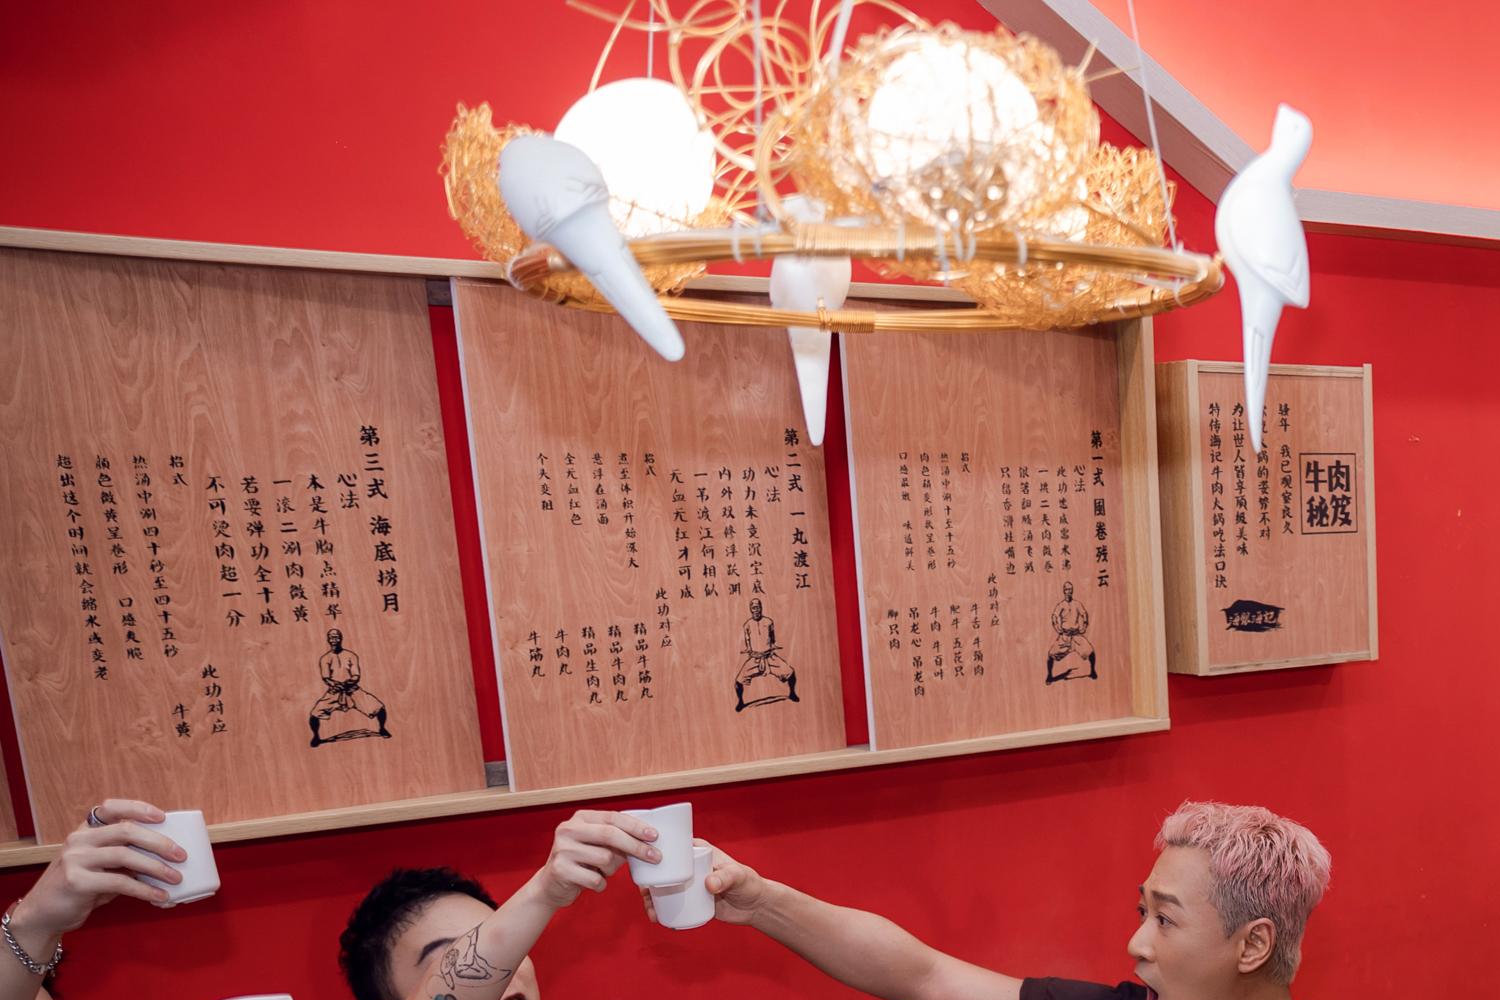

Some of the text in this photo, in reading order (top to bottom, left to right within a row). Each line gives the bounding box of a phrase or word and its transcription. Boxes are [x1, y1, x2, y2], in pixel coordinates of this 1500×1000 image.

[168, 454, 188, 487] 招式
[764, 465, 781, 503] 心法
[1073, 464, 1086, 493] 心法
[1090, 429, 1105, 487] 第一式
[1305, 460, 1350, 492] 牛肉
[336, 472, 360, 510] 心法
[784, 427, 812, 590] 第二式 一丸渡江
[1208, 402, 1228, 589] 特传海记牛肉火锅吃法口诀
[1306, 494, 1353, 527] 秘笈
[359, 424, 400, 613] 第三式 海底捞月
[204, 475, 246, 628] 不可烫肉超一分
[655, 586, 673, 649] 此功对应
[929, 605, 942, 632] 牛肉
[554, 628, 573, 676] 牛肉丸
[607, 624, 629, 703] 精品牛肉丸
[201, 663, 228, 735] 此功对应
